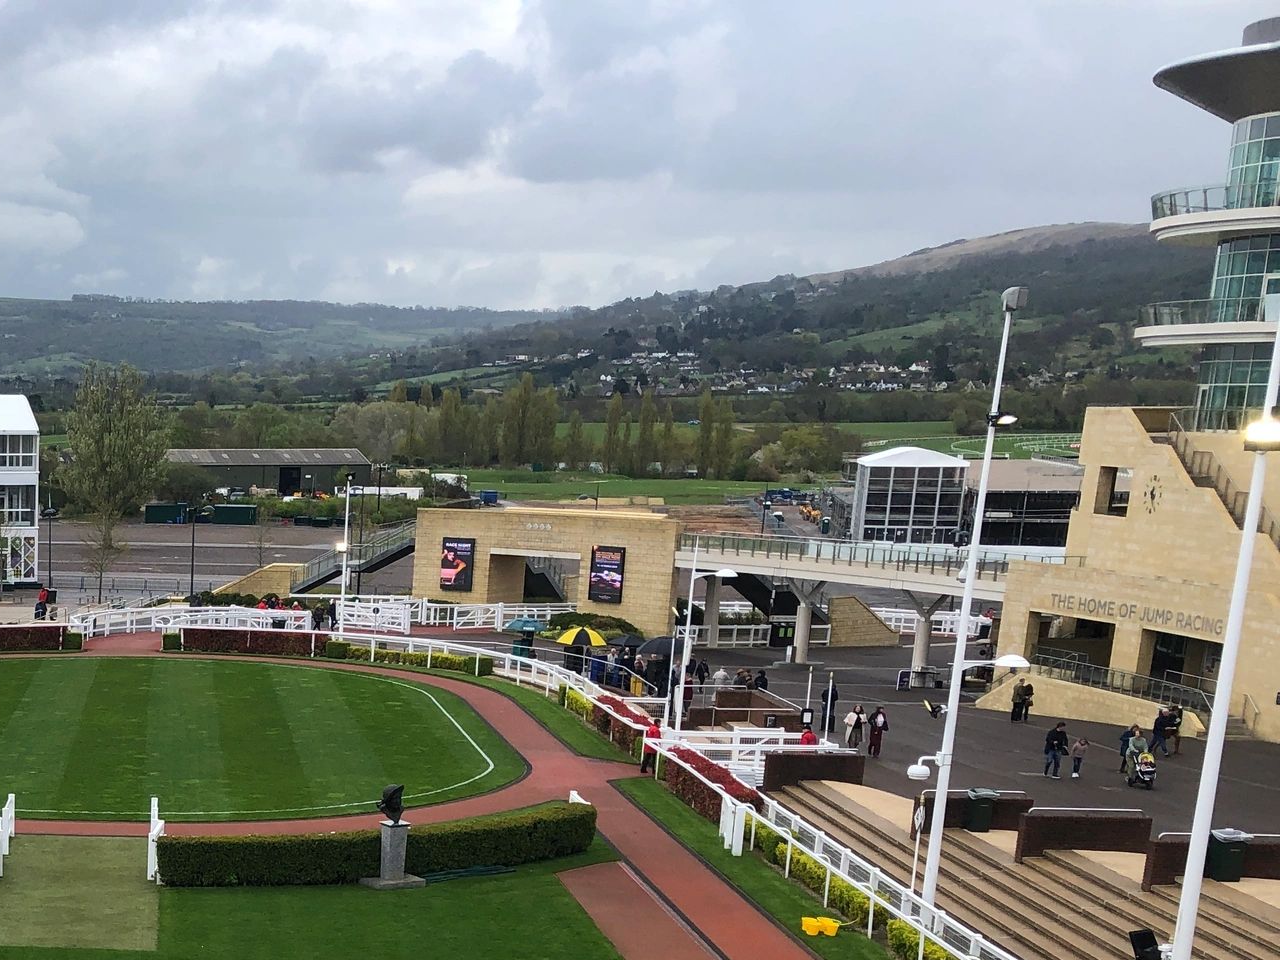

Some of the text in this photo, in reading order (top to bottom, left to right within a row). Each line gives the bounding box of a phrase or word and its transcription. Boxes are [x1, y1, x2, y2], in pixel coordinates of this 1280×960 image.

[1051, 593, 1224, 635] THE HOME OF JUMP RACING
